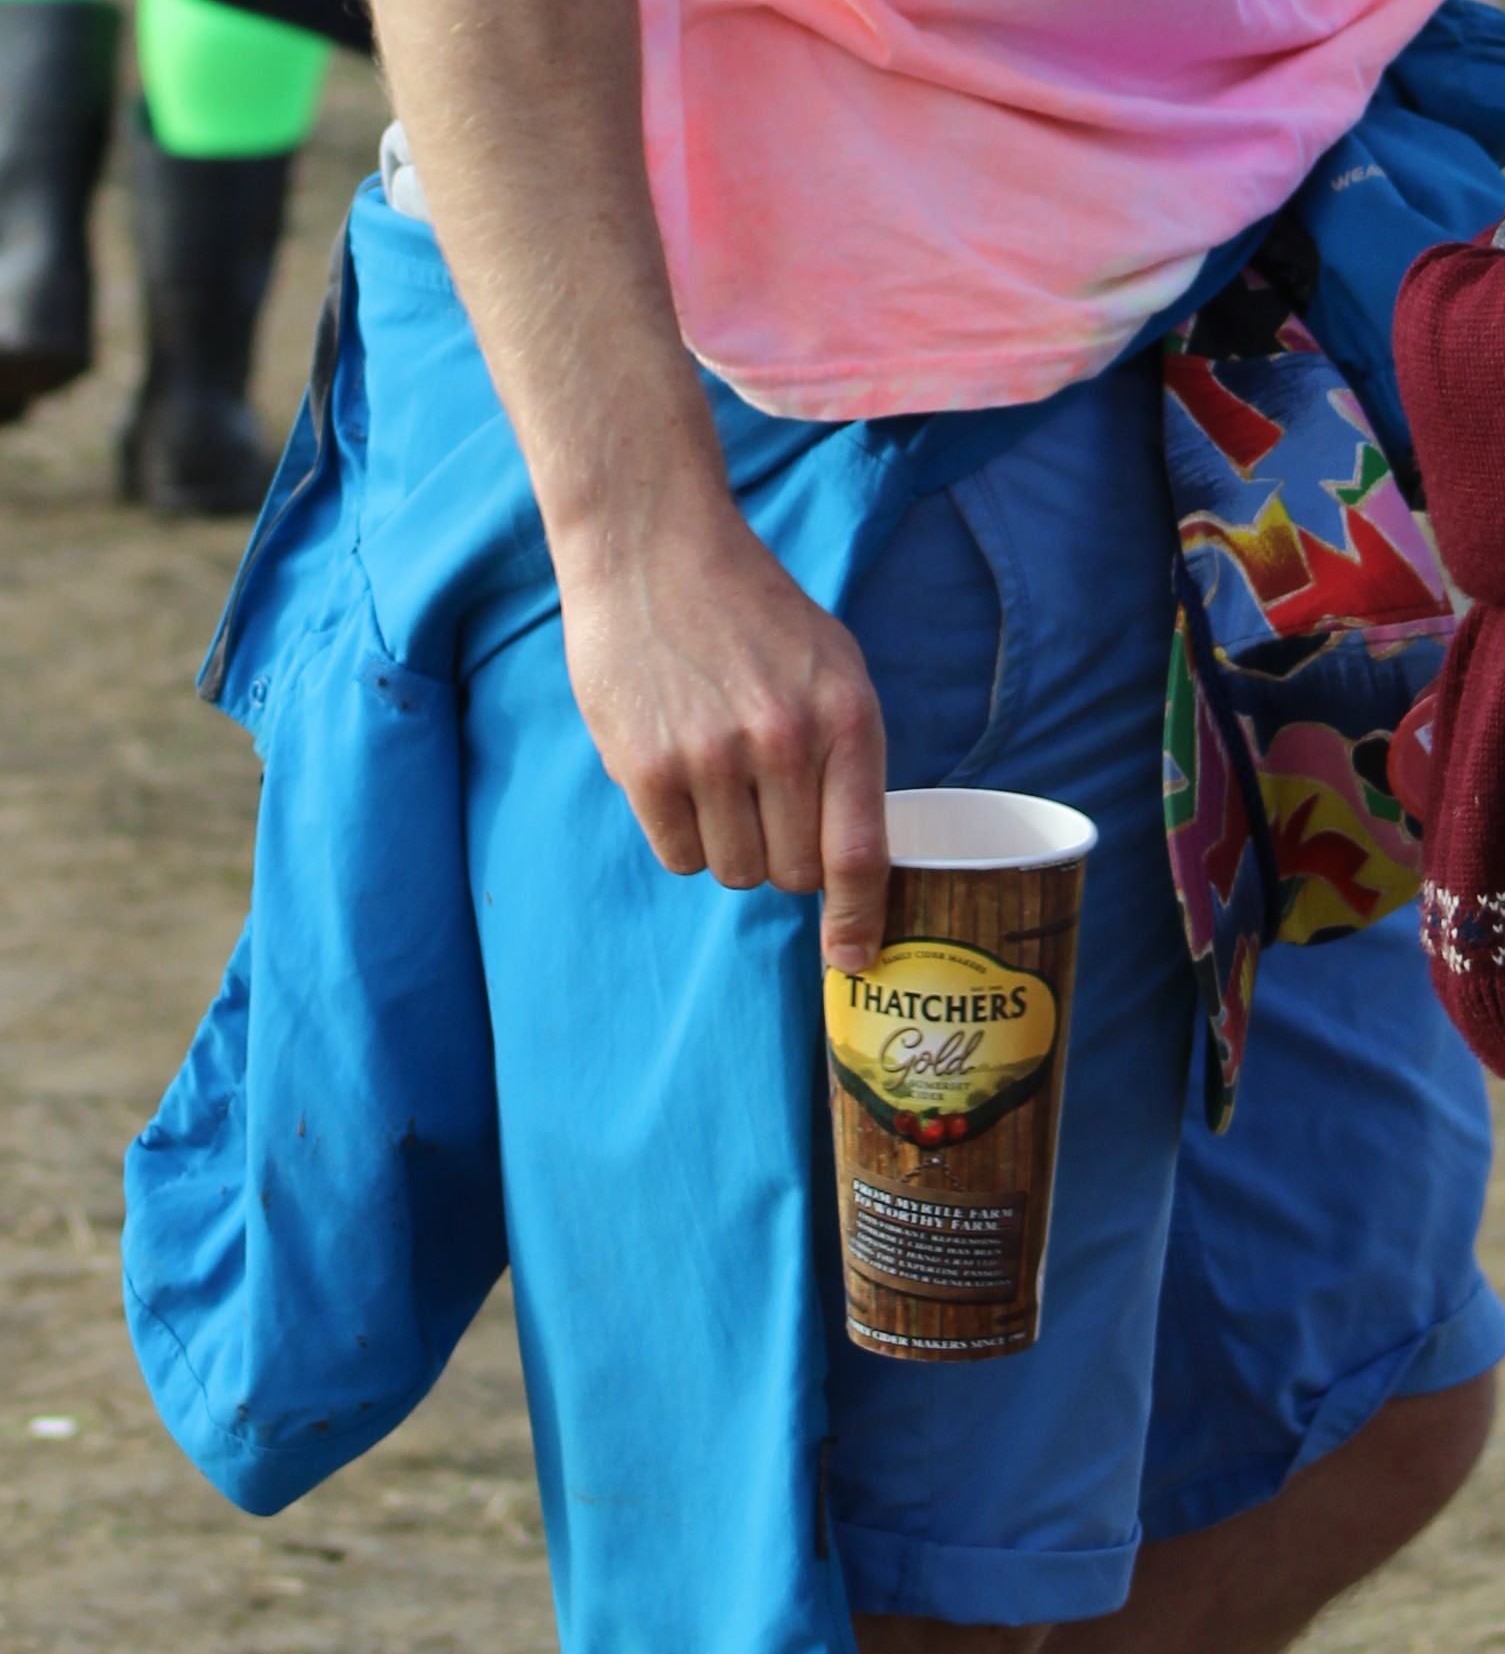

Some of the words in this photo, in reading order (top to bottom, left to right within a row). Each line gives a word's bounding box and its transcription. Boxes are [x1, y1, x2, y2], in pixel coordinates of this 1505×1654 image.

[845, 974, 1027, 1023] THATCHERS
[880, 1026, 985, 1091] Gold
[853, 1179, 892, 1205] FROM
[895, 1197, 964, 1219] MYRTLE
[969, 1208, 1014, 1219] FARM
[854, 1191, 873, 1208] TO
[872, 1201, 943, 1228] WORTHY
[872, 1330, 909, 1347] CIDER
[911, 1339, 967, 1350] MAKERS
